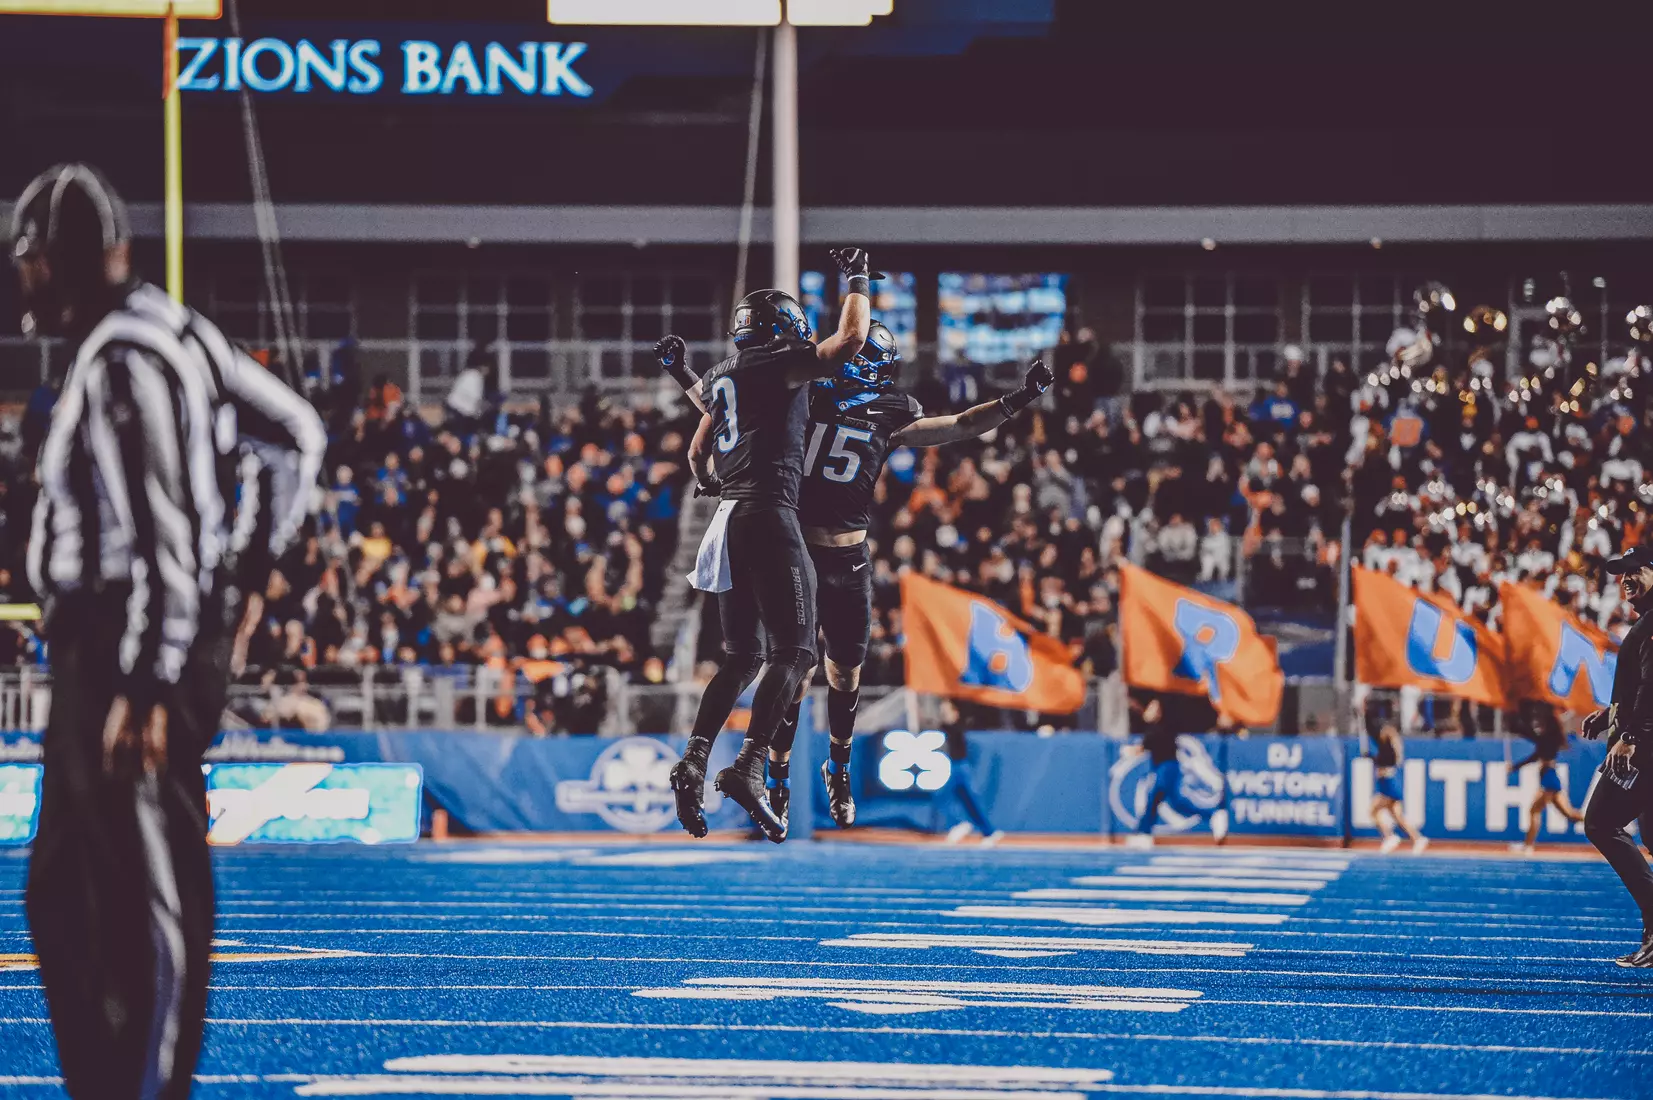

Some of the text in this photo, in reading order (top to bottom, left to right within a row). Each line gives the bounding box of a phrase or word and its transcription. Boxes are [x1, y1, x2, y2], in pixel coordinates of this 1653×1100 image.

[175, 37, 594, 97] ZIONS BANK
[711, 376, 739, 452] 3
[803, 422, 873, 483] 15
[790, 566, 806, 625] BRONCOS
[1173, 597, 1241, 703] R
[1405, 597, 1479, 683] U
[1226, 770, 1341, 799] VICTORY
[1266, 742, 1303, 768] DJ
[1229, 799, 1336, 827] TUNNEL
